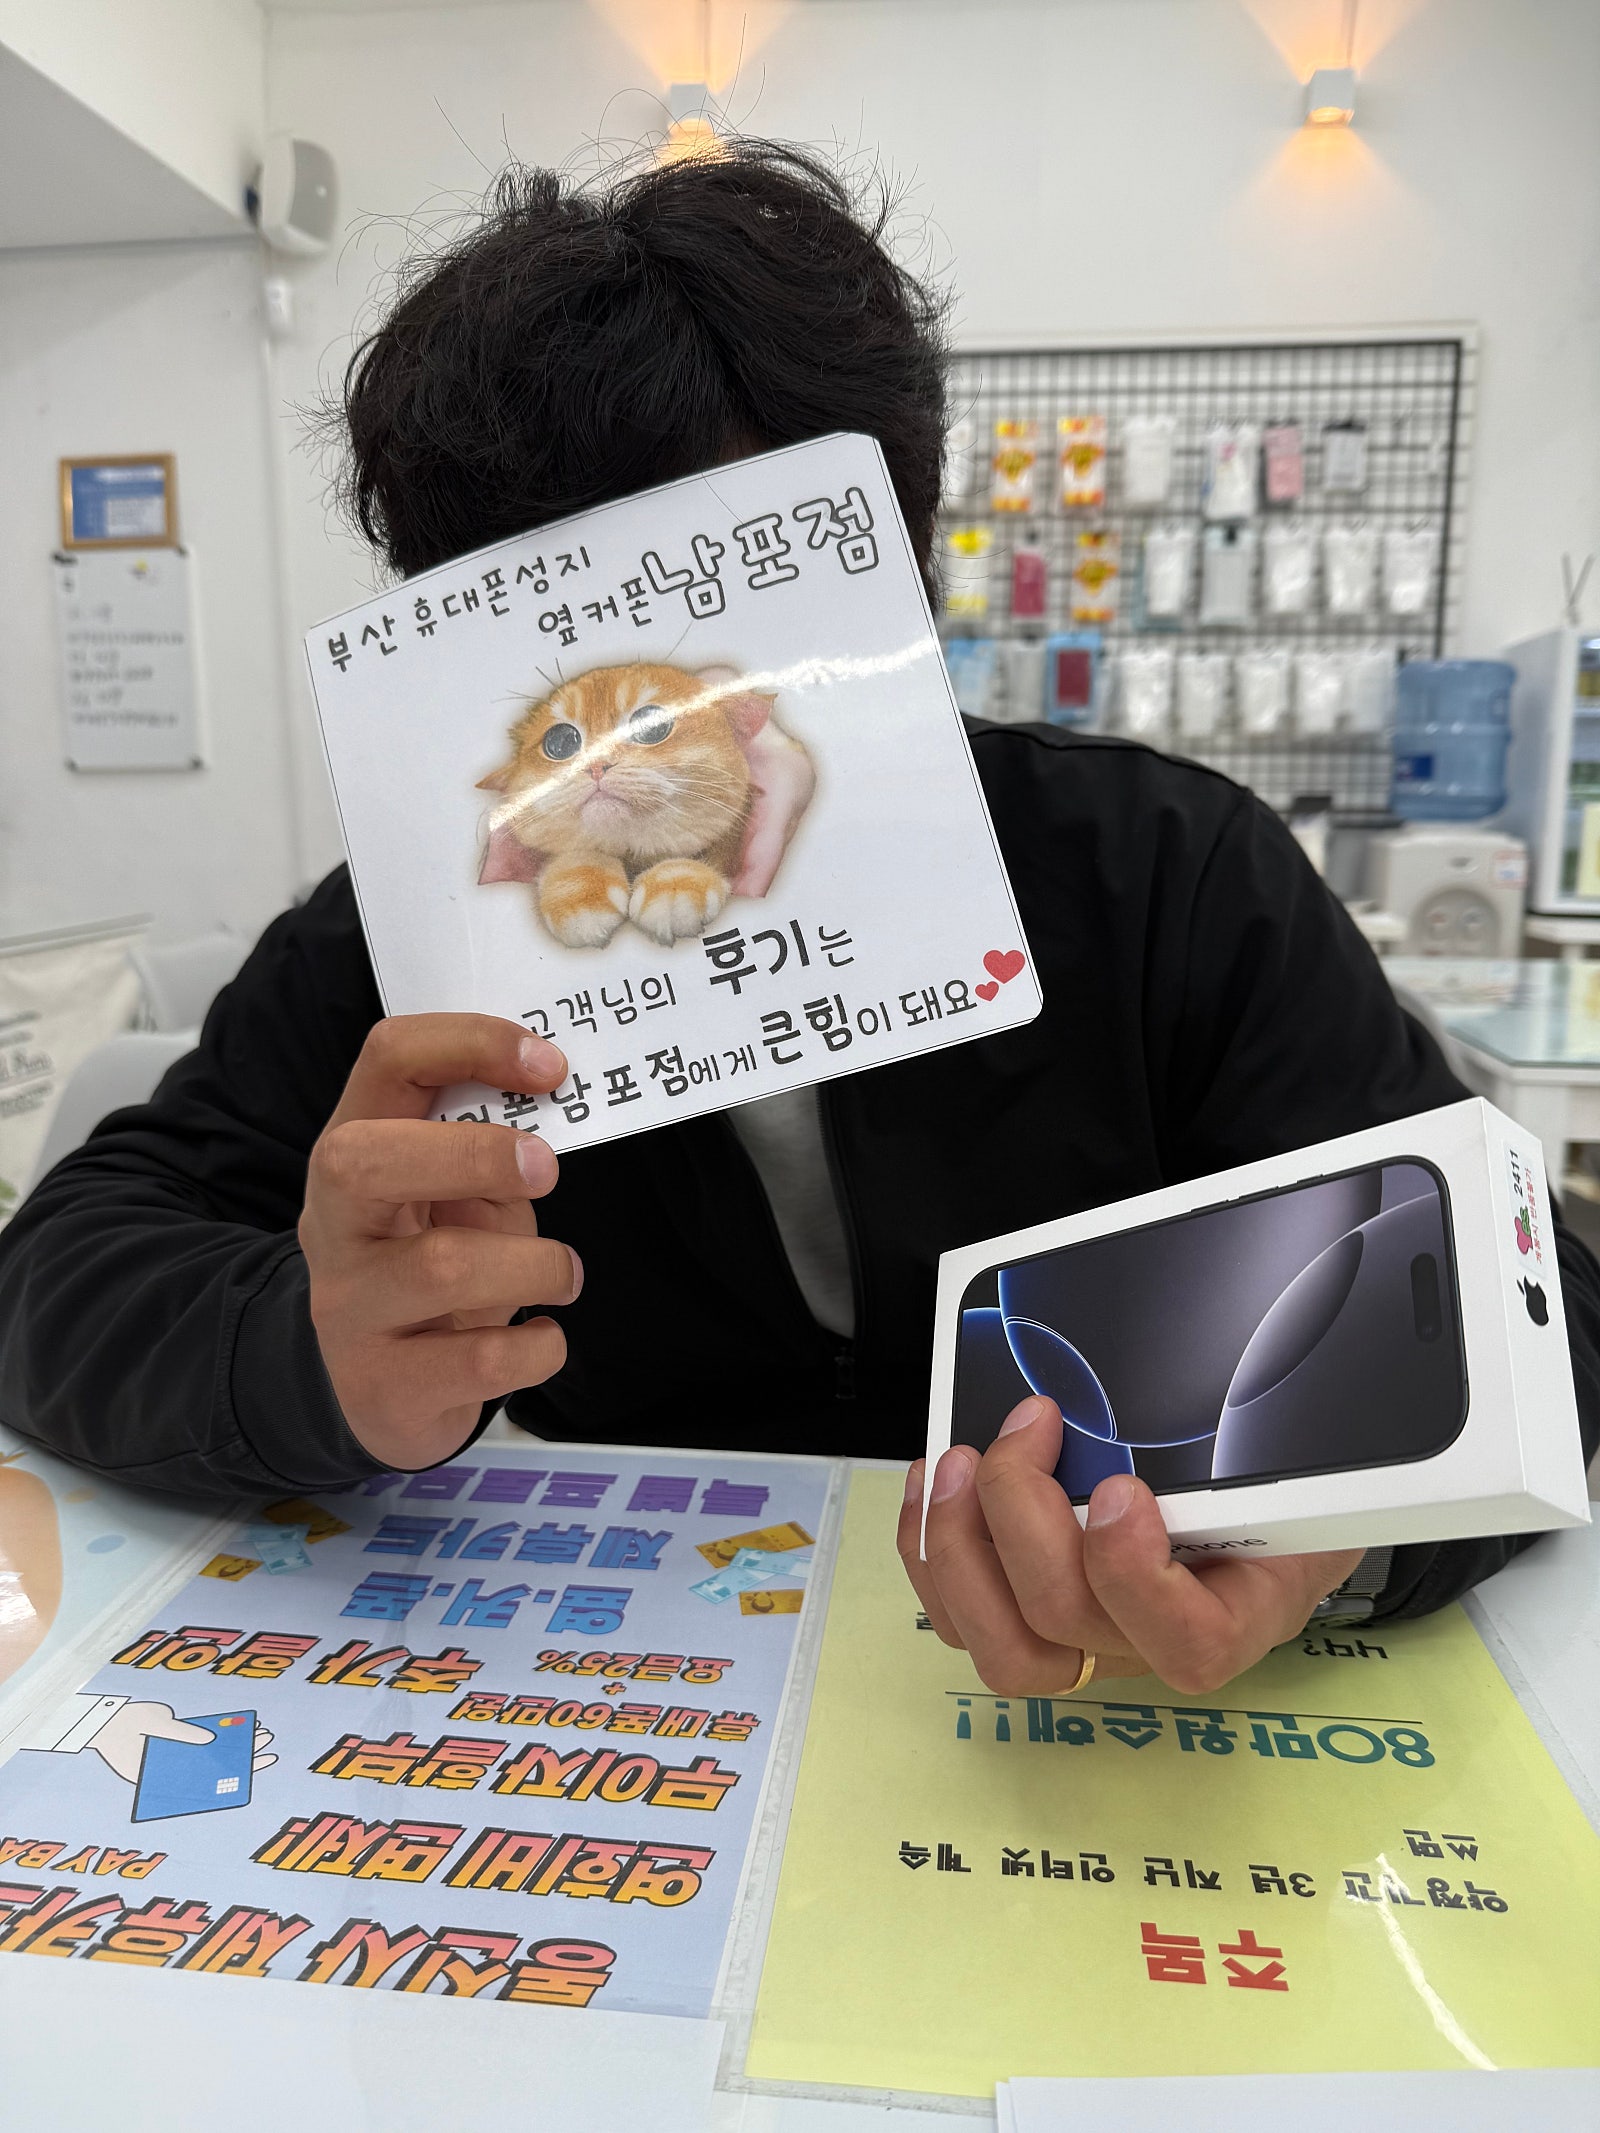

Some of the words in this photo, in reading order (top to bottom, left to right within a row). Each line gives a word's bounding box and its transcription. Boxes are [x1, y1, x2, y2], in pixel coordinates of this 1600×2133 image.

[328, 614, 398, 673] 부산
[413, 545, 592, 638] 휴대폰성지
[702, 919, 855, 996] 후기는
[898, 979, 978, 1027] 돼요
[1510, 1149, 1524, 1198] 2411
[625, 1474, 770, 1517] 특별
[363, 1514, 674, 1571] 제휴카드
[110, 1625, 323, 1679] 할인!
[304, 1638, 485, 1693] 추가
[532, 1649, 735, 1684] 요금25%
[307, 1731, 511, 1790] 할부!
[487, 1734, 742, 1811] 무이자
[50, 1845, 170, 1880] PAY
[249, 1810, 469, 1884] 면제!
[441, 1826, 718, 1907] 연회비
[899, 1840, 972, 1874] 계속
[1001, 1846, 1116, 1883] 인터넷
[1403, 1829, 1480, 1862] 쓰면
[1143, 1857, 1222, 1891] 지난
[1249, 1864, 1317, 1898] 3년
[1342, 1871, 1510, 1914] 약정기간
[295, 1917, 617, 2008] 통신사
[1140, 1922, 1290, 1992] 주목
